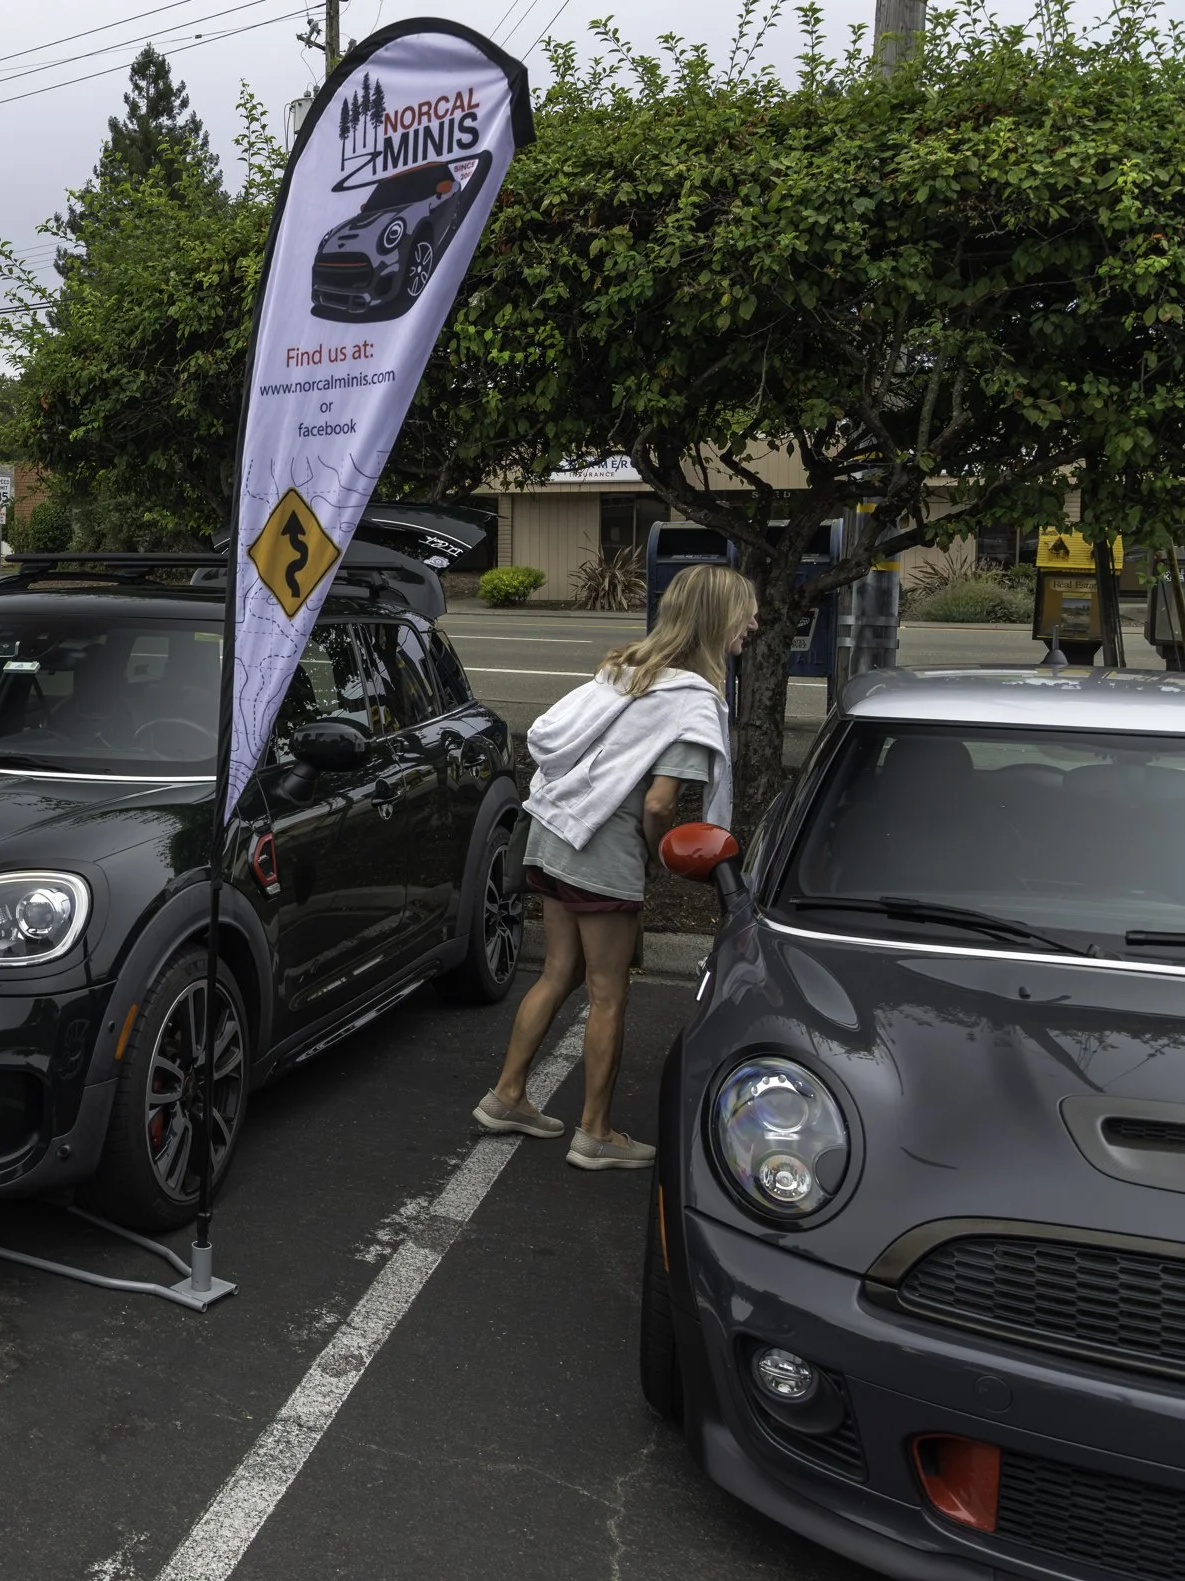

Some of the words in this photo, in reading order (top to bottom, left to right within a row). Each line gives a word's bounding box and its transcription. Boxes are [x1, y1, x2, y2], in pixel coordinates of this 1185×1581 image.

[383, 87, 480, 136] NORCAL
[382, 111, 480, 172] MINIS
[286, 343, 323, 368] Find
[328, 346, 347, 363] us
[352, 340, 374, 360] at:
[259, 370, 396, 396] www.norcalminis.com
[320, 401, 334, 413] or
[298, 419, 357, 438] facebook
